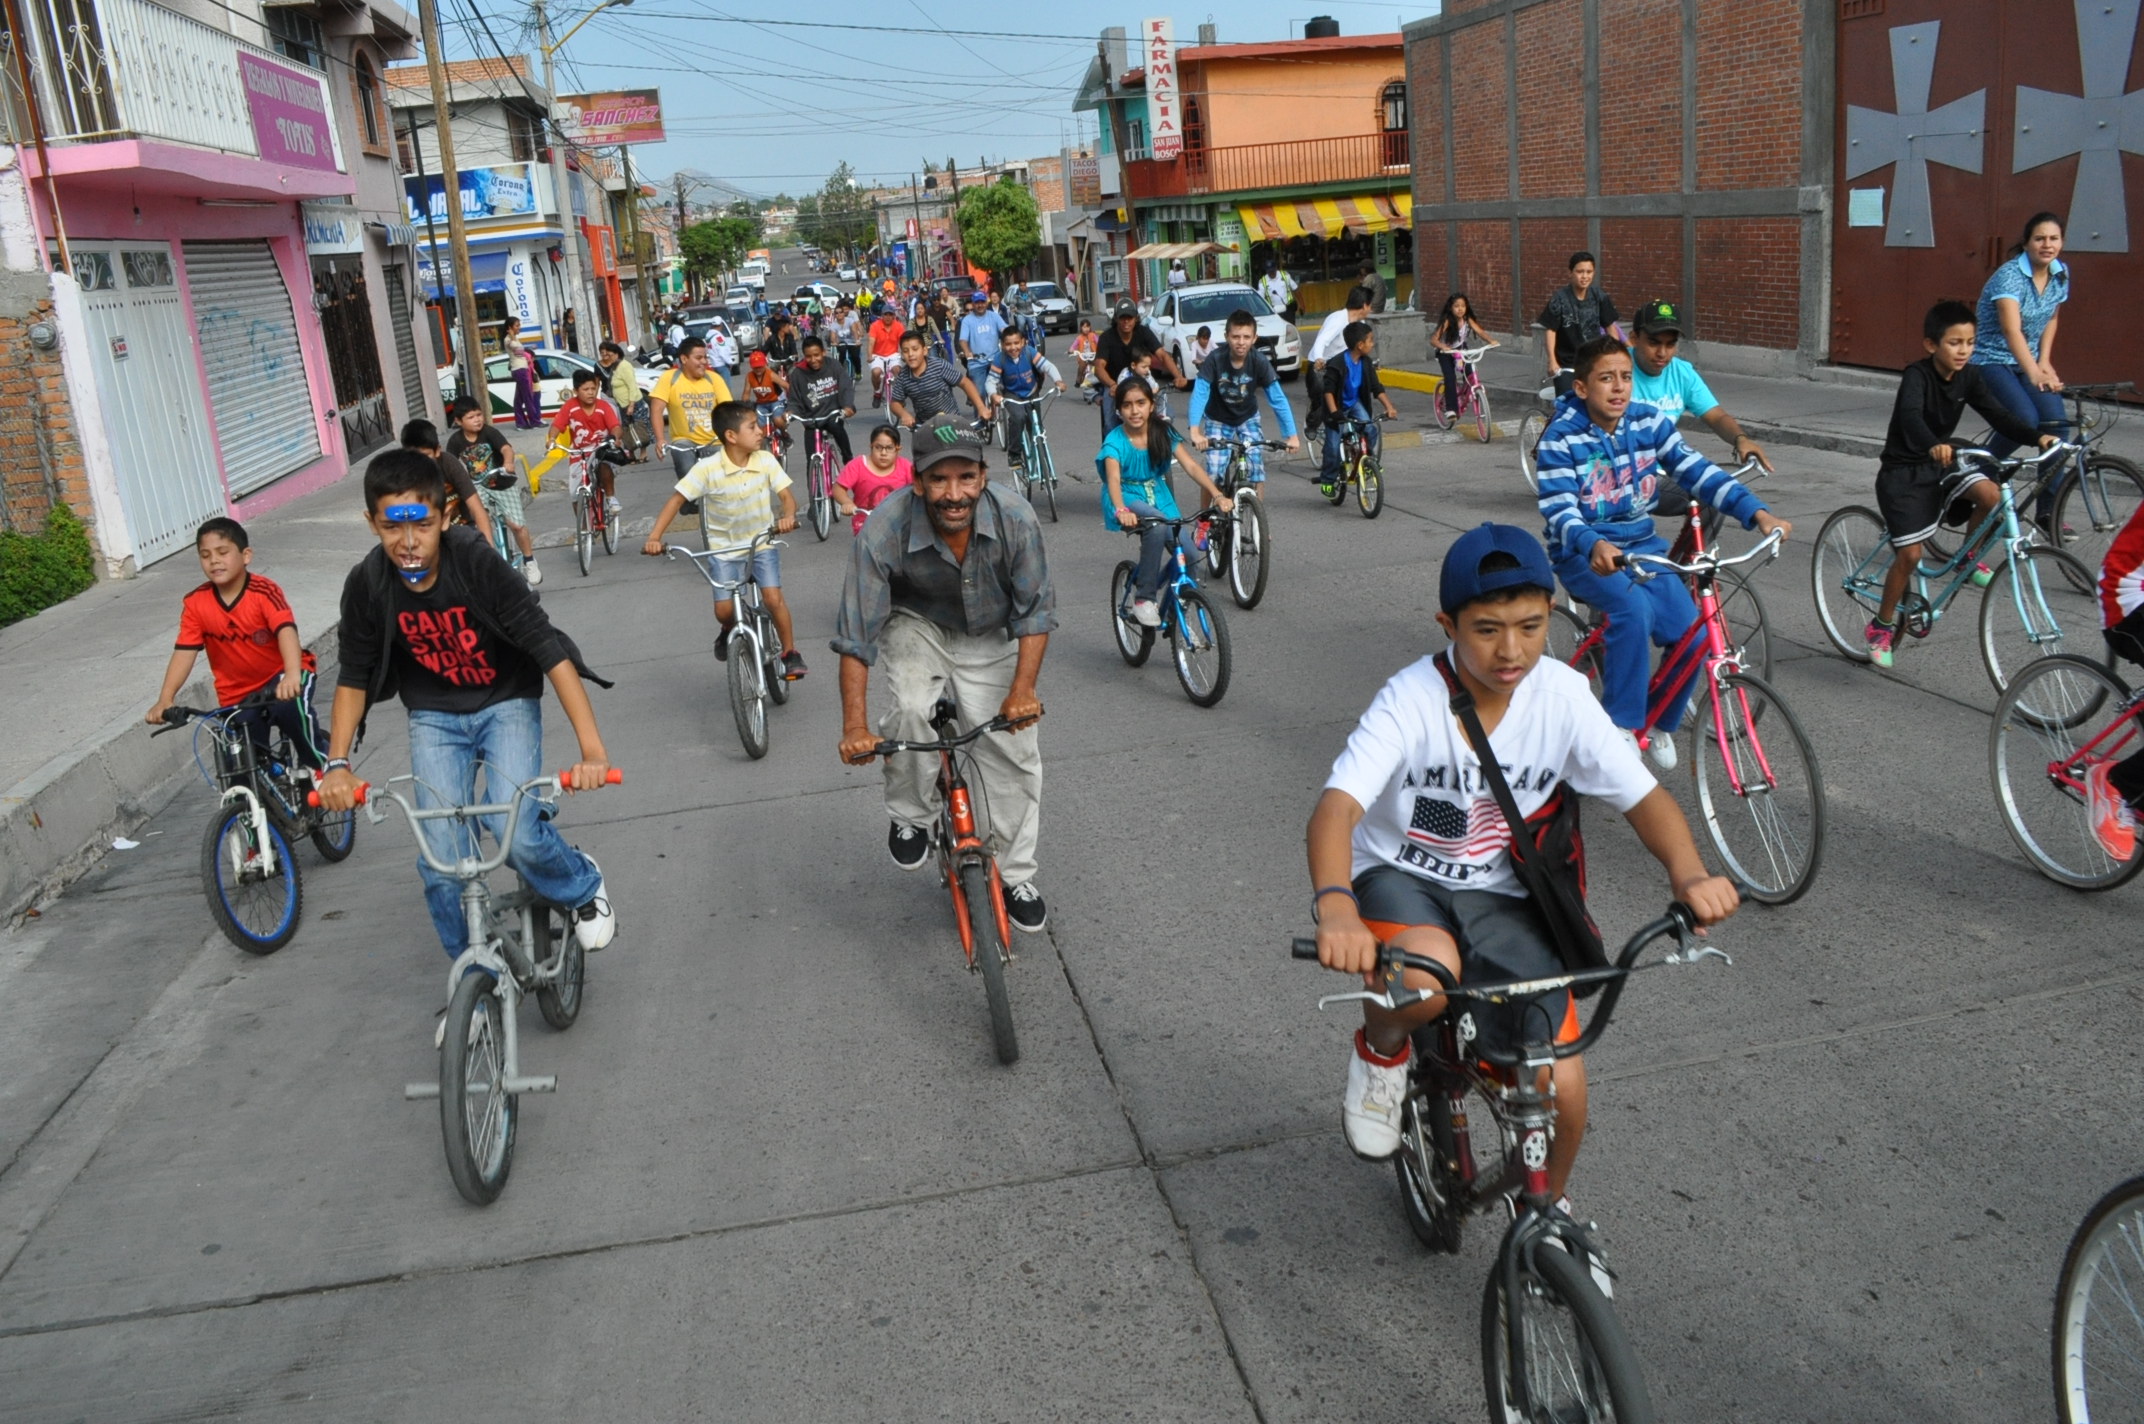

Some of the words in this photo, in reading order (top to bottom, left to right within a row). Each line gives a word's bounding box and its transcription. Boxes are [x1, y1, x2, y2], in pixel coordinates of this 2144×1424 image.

[1151, 21, 1173, 132] FARMACIA
[581, 105, 658, 127] SANCHEZ
[1154, 138, 1166, 149] SAN
[1166, 136, 1180, 148] JUAN
[1155, 148, 1180, 160] BOSCO
[1073, 168, 1098, 176] DIEGO
[490, 175, 524, 191] Corona
[511, 262, 530, 318] Corona
[407, 628, 478, 656] STOP
